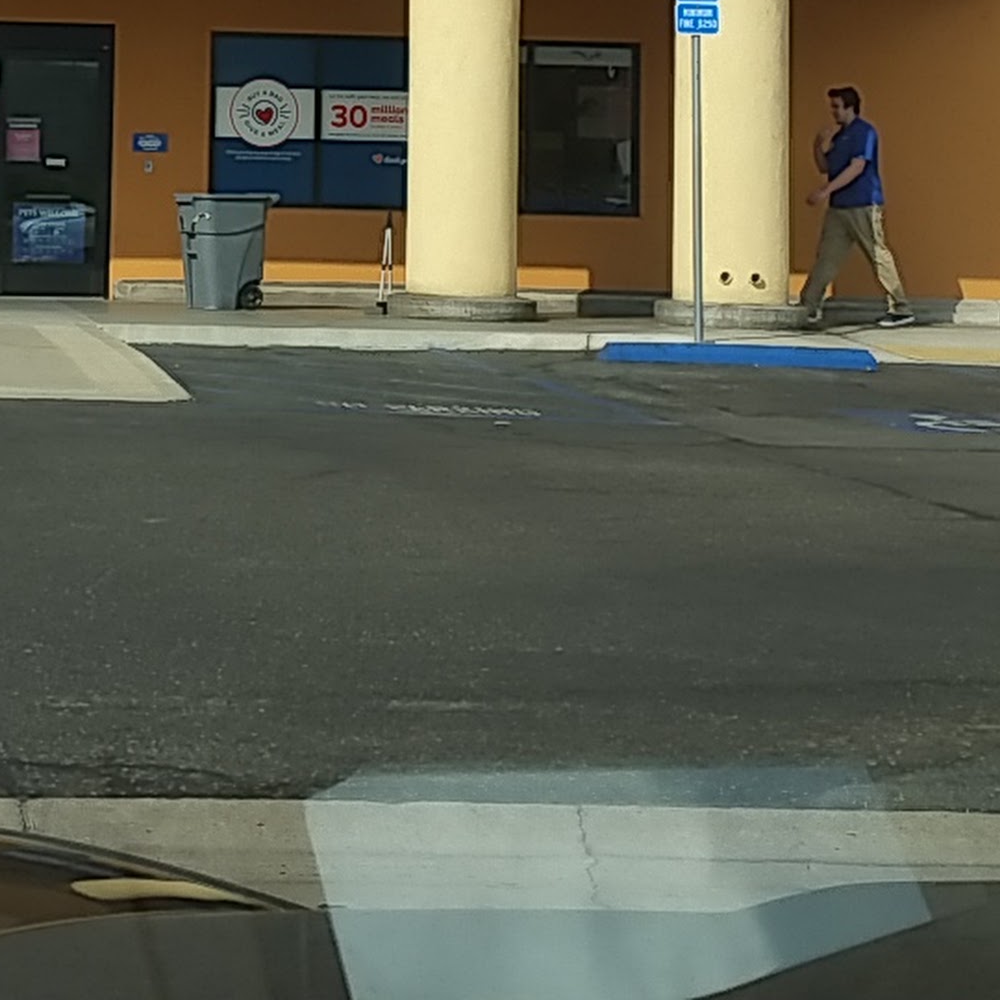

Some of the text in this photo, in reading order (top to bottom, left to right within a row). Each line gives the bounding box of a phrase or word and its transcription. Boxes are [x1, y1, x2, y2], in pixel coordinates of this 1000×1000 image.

[371, 104, 408, 114] million
[331, 104, 368, 129] 30
[371, 115, 404, 124] meals
